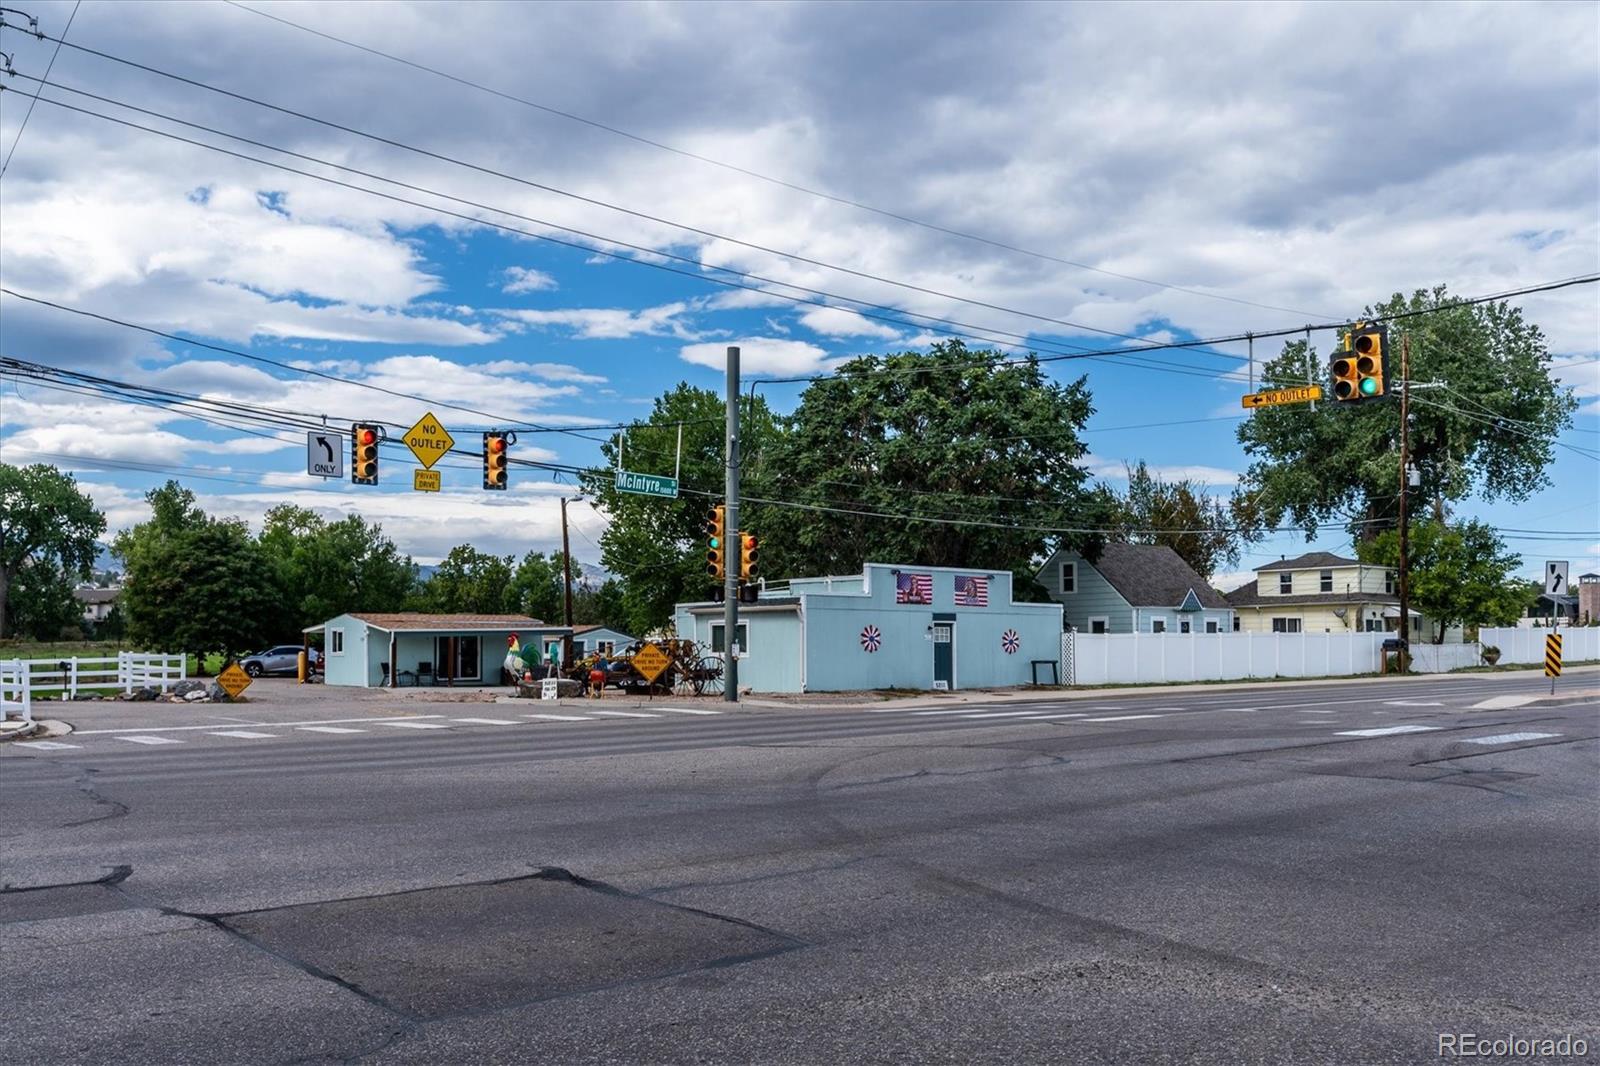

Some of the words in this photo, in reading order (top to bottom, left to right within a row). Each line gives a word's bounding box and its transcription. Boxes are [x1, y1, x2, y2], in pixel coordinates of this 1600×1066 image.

[1266, 393, 1278, 403] NO
[1280, 388, 1311, 402] OUTLET
[422, 424, 436, 435] NO
[410, 437, 447, 450] OUTLET
[314, 463, 336, 474] ONLY
[416, 471, 439, 481] PRIVATE
[419, 480, 436, 489] DRIVE
[617, 473, 660, 493] McIntyre
